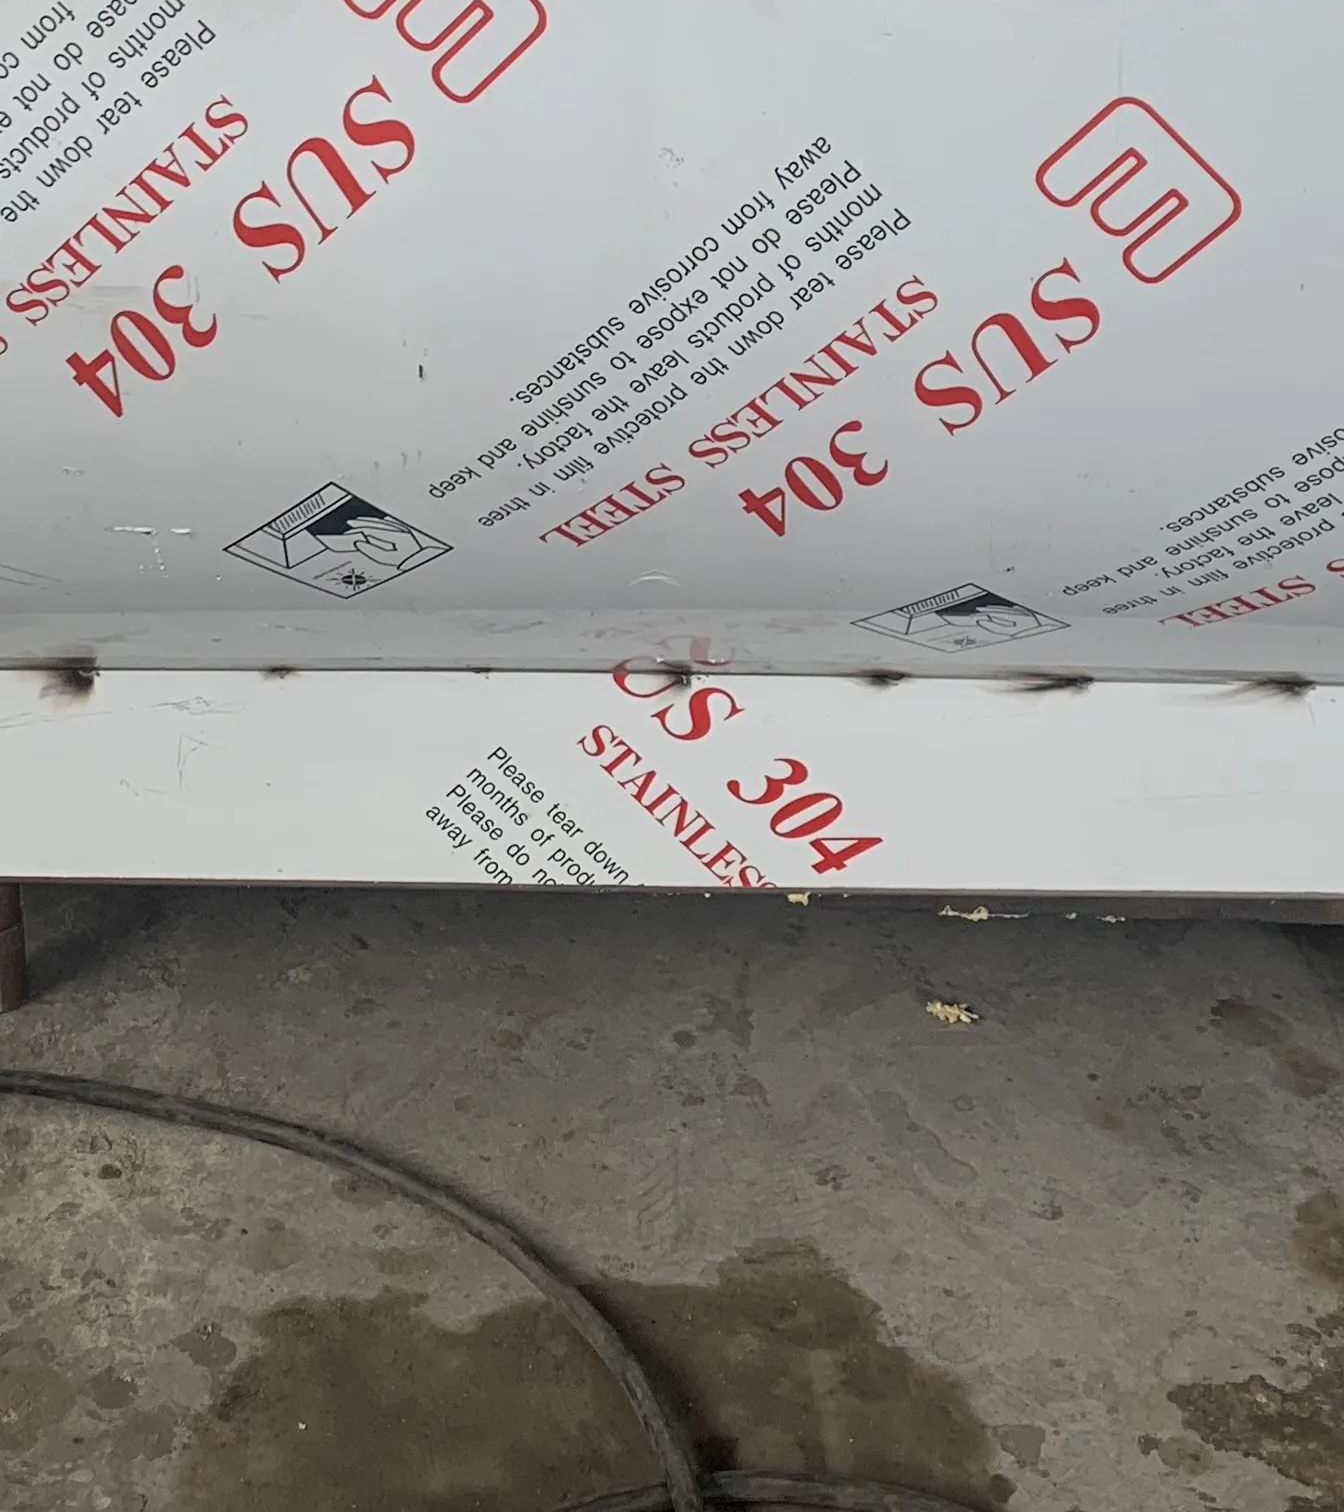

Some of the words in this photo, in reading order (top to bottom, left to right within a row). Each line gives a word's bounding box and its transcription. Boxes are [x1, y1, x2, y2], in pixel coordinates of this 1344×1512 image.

[18, 0, 76, 51] from
[52, 40, 84, 72] do
[139, 18, 217, 89] Please
[11, 71, 53, 113] not
[79, 70, 107, 102] of
[94, 89, 144, 136] tear
[34, 134, 94, 189] down
[232, 74, 417, 283] SUS
[5, 95, 250, 326] STAINLESS
[783, 158, 863, 226] Please
[750, 226, 782, 255] do
[833, 206, 913, 271] Please
[708, 254, 750, 291] not
[787, 270, 837, 312] tear
[65, 263, 219, 418] 304
[634, 287, 710, 350] expose
[726, 309, 786, 357] down
[608, 349, 638, 371] to
[688, 355, 730, 386] the
[688, 273, 939, 470] STAINLESS
[913, 257, 1101, 436] SUS
[519, 370, 608, 438] sunshine
[592, 380, 689, 456] protective
[427, 464, 483, 499] keep
[475, 437, 518, 471] and
[551, 454, 595, 482] film
[738, 418, 890, 538] 304
[476, 495, 532, 528] three
[527, 480, 557, 498] in
[538, 461, 687, 547] STEEL
[1158, 465, 1286, 533] substances.
[1262, 492, 1292, 510] to
[1163, 507, 1259, 557] sunshine
[1061, 573, 1118, 597] keep
[1115, 555, 1159, 579] and
[1158, 573, 1317, 628] STEEL
[445, 783, 505, 842] Please
[505, 842, 531, 867] do
[465, 767, 530, 827] months
[529, 828, 557, 848] of
[486, 745, 546, 804] Please
[545, 802, 585, 839] tear
[583, 839, 631, 885] down
[576, 723, 778, 888] STAINLES
[725, 756, 885, 875] 304
[424, 804, 474, 850] away
[472, 847, 514, 885] from
